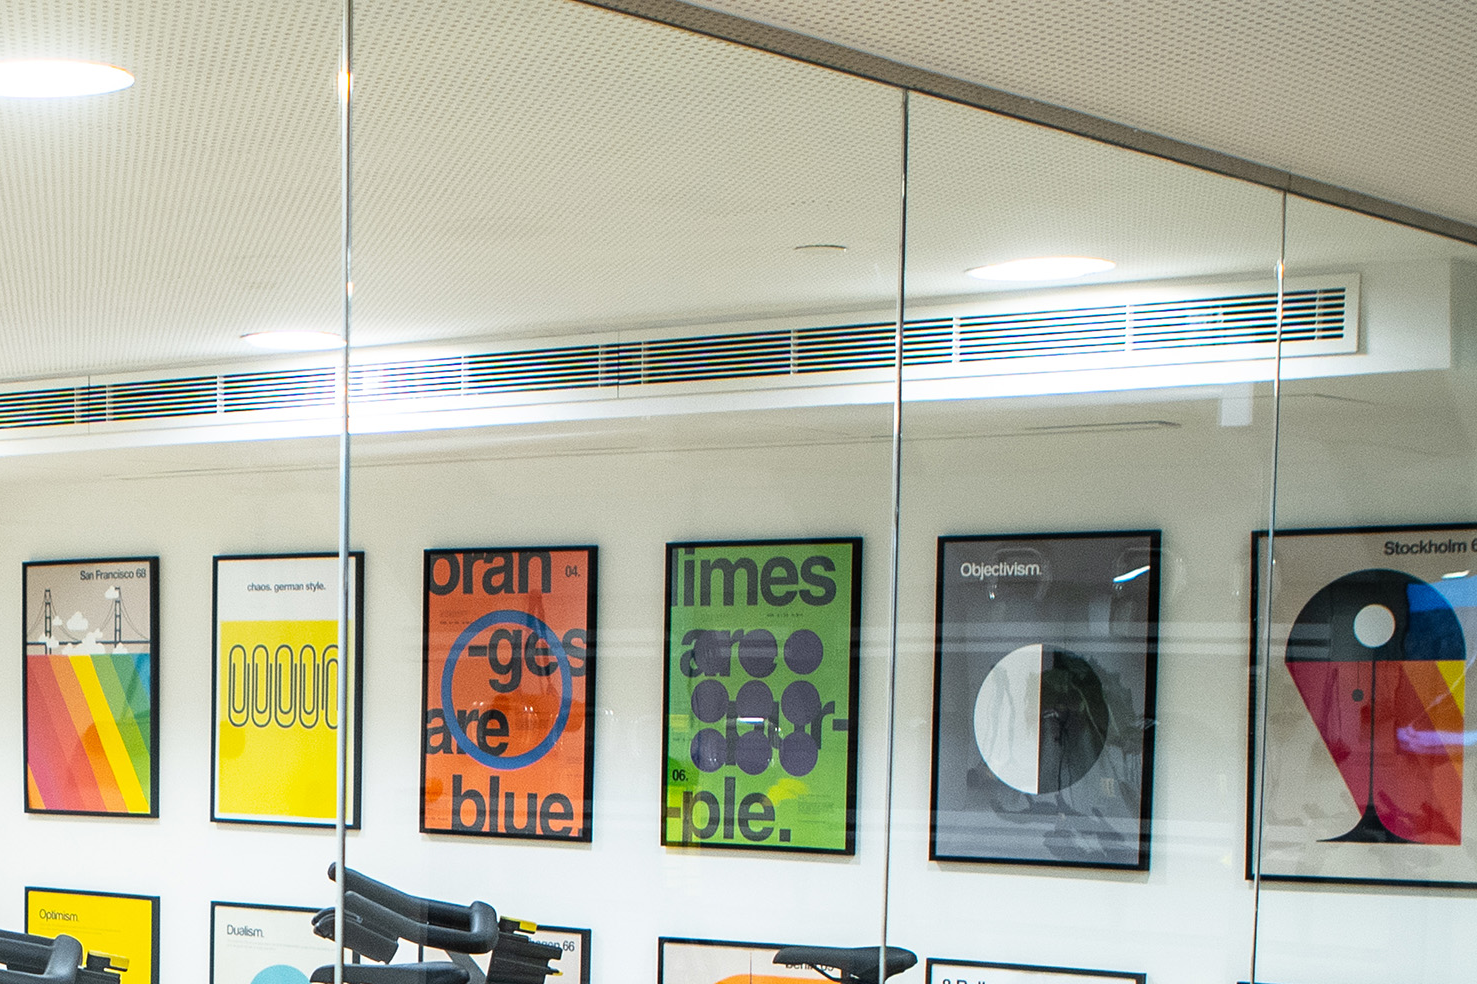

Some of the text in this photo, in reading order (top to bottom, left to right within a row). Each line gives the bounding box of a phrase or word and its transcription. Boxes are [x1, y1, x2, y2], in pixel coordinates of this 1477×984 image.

[1384, 538, 1467, 556] Stockholm
[79, 567, 146, 580] San Francisco 68
[429, 551, 552, 596] oran
[564, 564, 581, 578] 04.
[671, 547, 837, 607] limes
[960, 561, 1043, 581] Objectivism.
[247, 581, 326, 593] chaos. german style.
[679, 628, 778, 678] ar
[426, 707, 510, 757] are
[671, 769, 689, 782] 06.
[226, 923, 265, 938] Dualism.
[562, 940, 575, 952] 66
